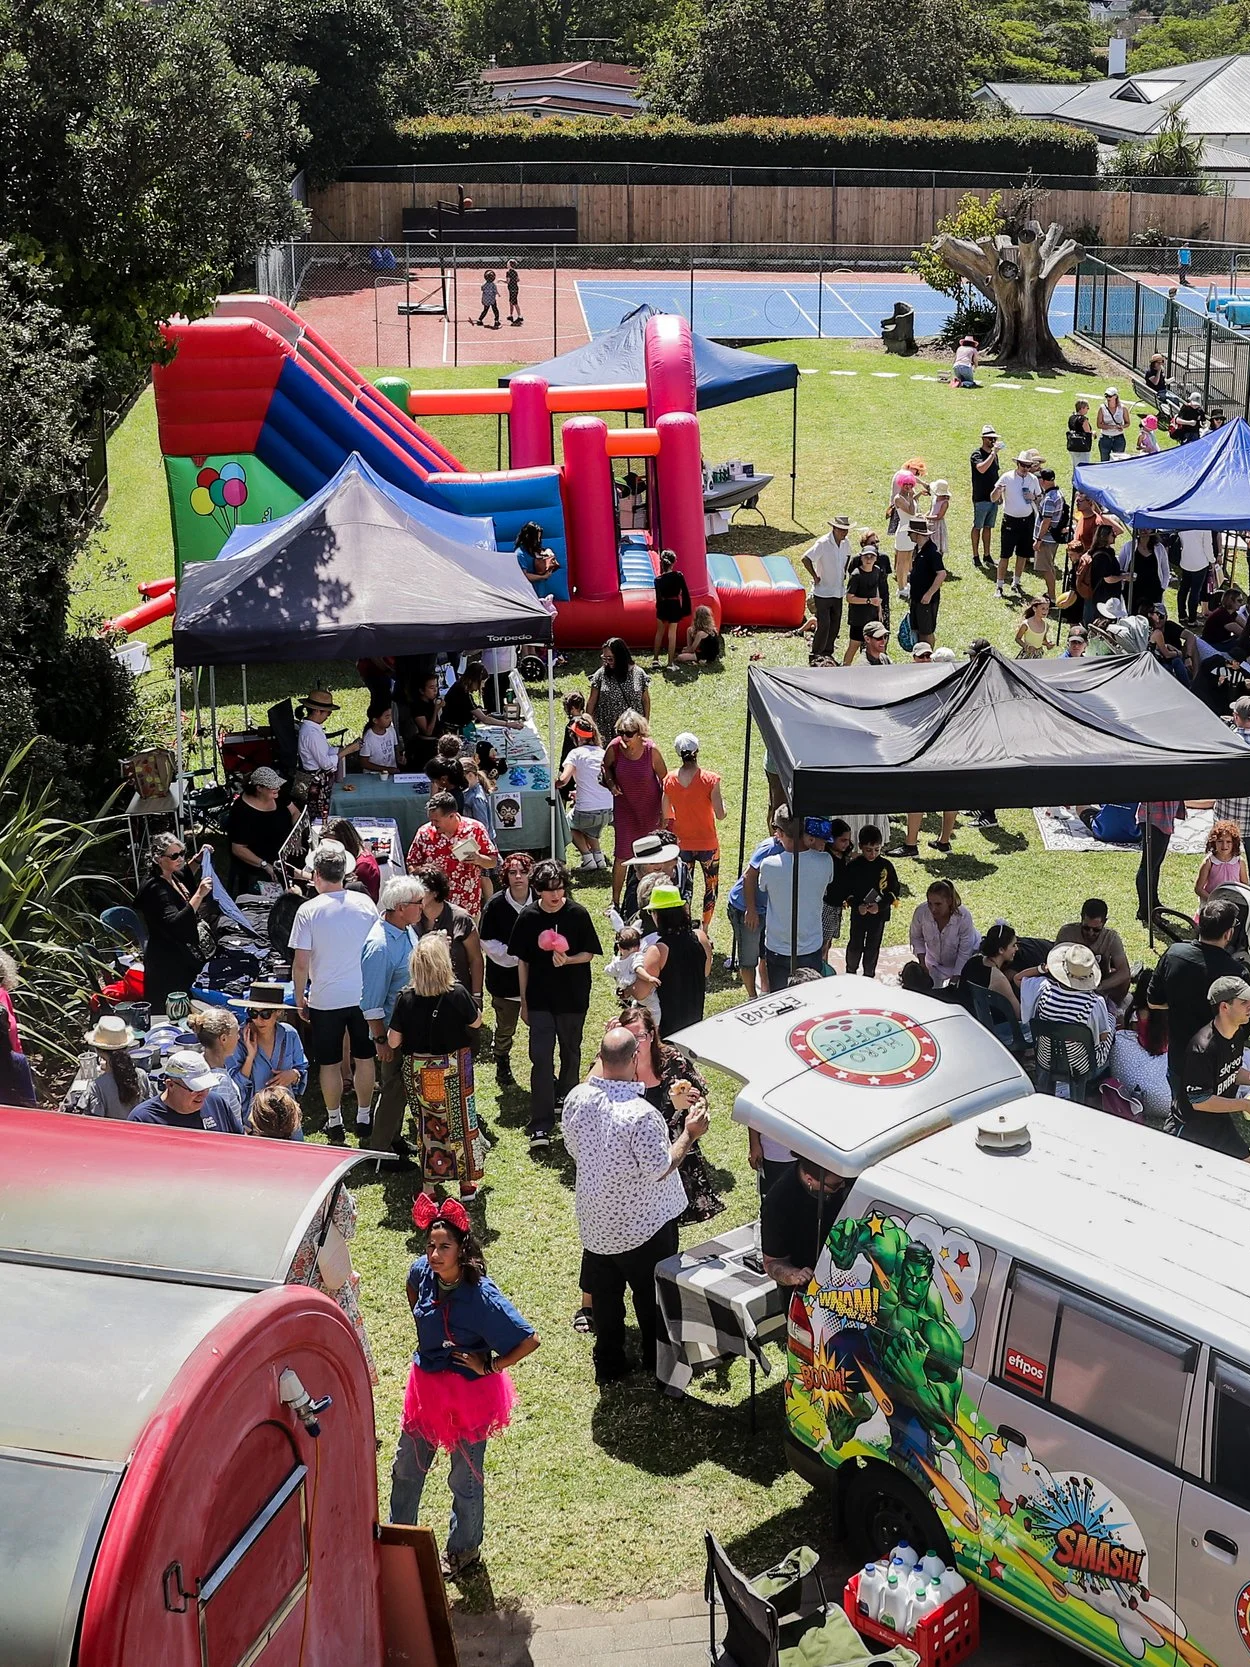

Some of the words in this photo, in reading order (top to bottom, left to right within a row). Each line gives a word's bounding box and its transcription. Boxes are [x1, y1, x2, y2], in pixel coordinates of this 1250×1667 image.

[486, 633, 533, 642] Torpedo
[820, 1022, 893, 1057] COFFEE
[849, 1037, 904, 1063] HERO
[818, 1287, 880, 1325] WHAM!
[801, 1364, 848, 1393] BOOM!
[1008, 1354, 1044, 1380] eftpos
[1055, 1527, 1143, 1584] SMASH!
